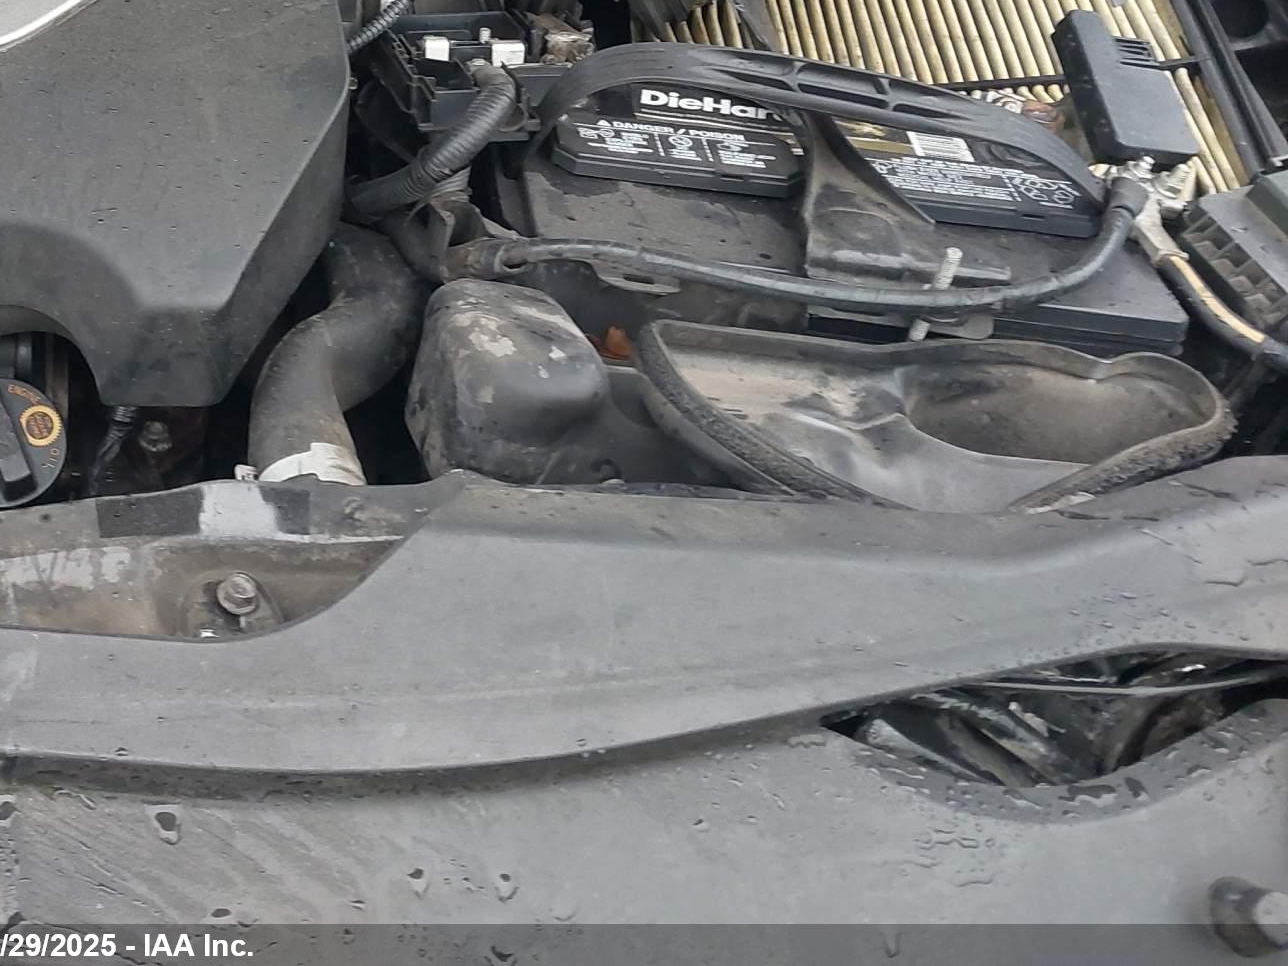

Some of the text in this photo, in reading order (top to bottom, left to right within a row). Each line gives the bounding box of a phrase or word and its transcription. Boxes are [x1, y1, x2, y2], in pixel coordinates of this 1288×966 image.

[639, 89, 782, 122] DieHar
[612, 121, 676, 135] DANGER
[688, 130, 745, 142] POISON
